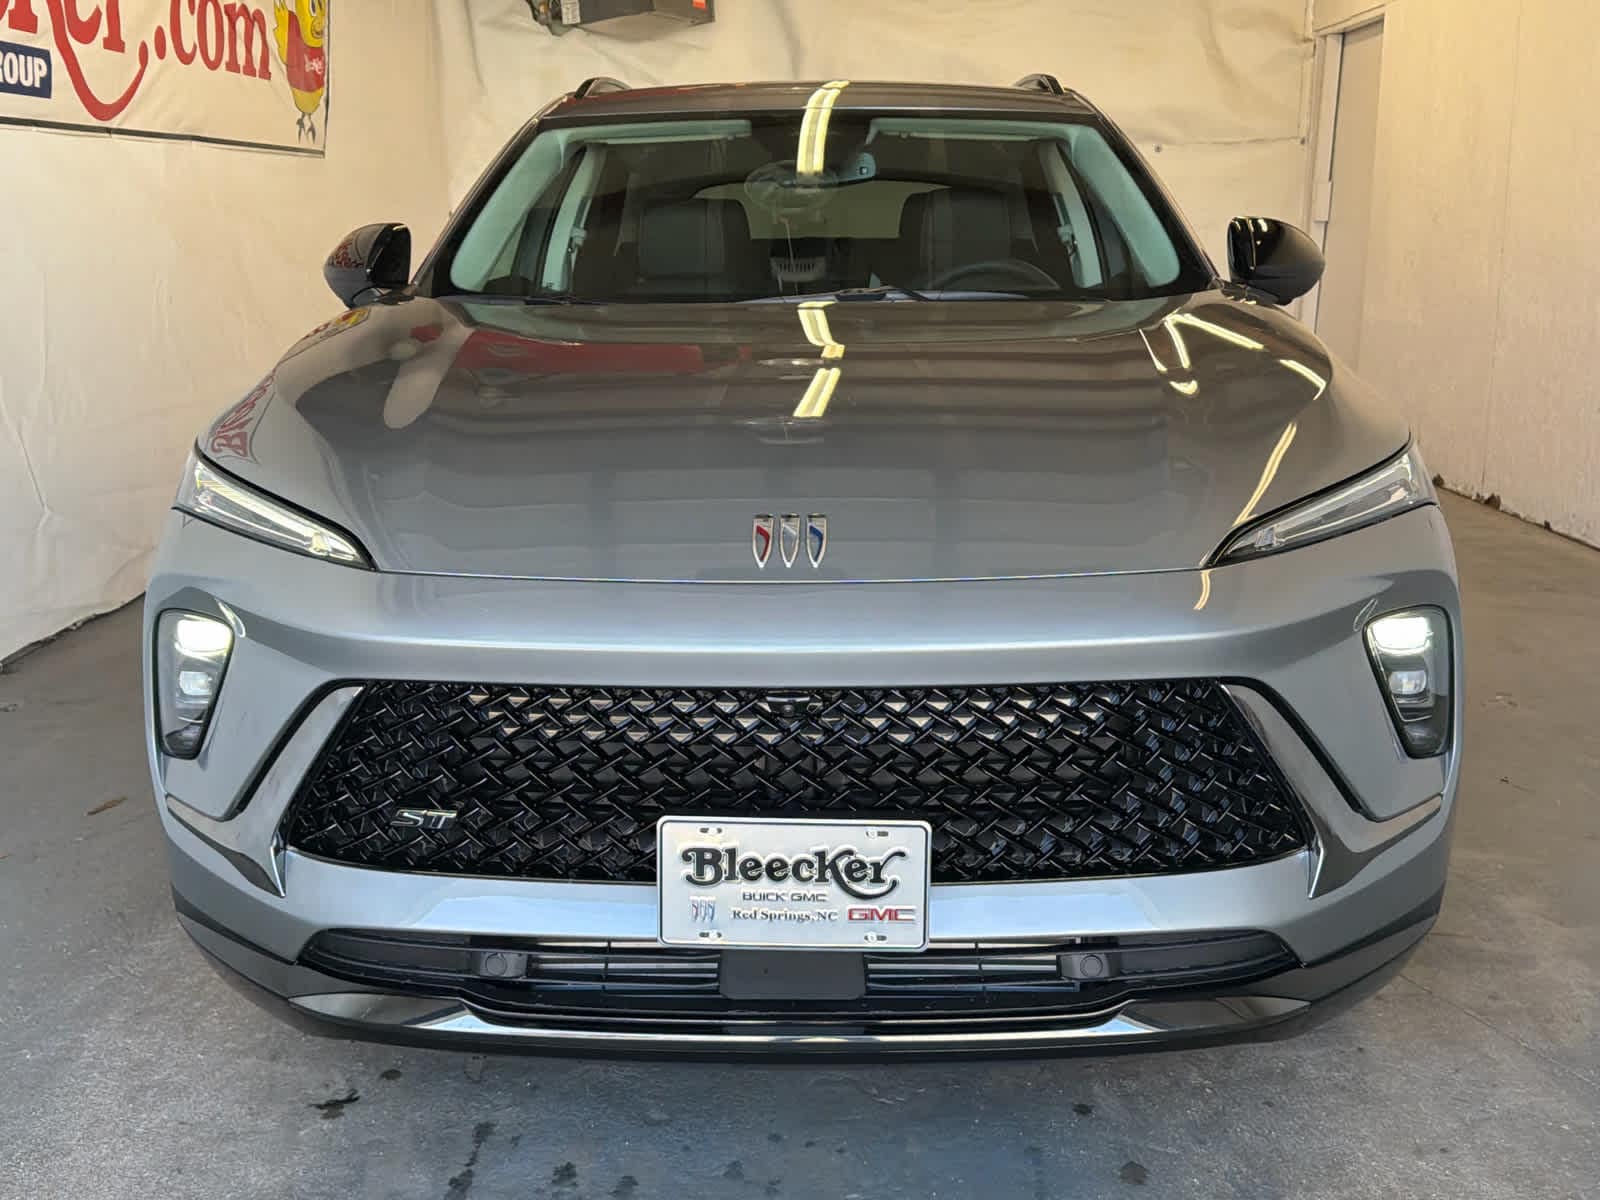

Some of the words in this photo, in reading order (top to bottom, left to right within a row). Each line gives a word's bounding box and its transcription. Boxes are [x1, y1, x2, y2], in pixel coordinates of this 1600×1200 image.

[0, 51, 48, 88] OUP
[742, 891, 785, 902] BUICK
[790, 892, 828, 902] GMC
[732, 909, 757, 921] Red
[760, 909, 815, 923] Springs,
[817, 910, 838, 921] NC
[847, 907, 915, 921] GMC
